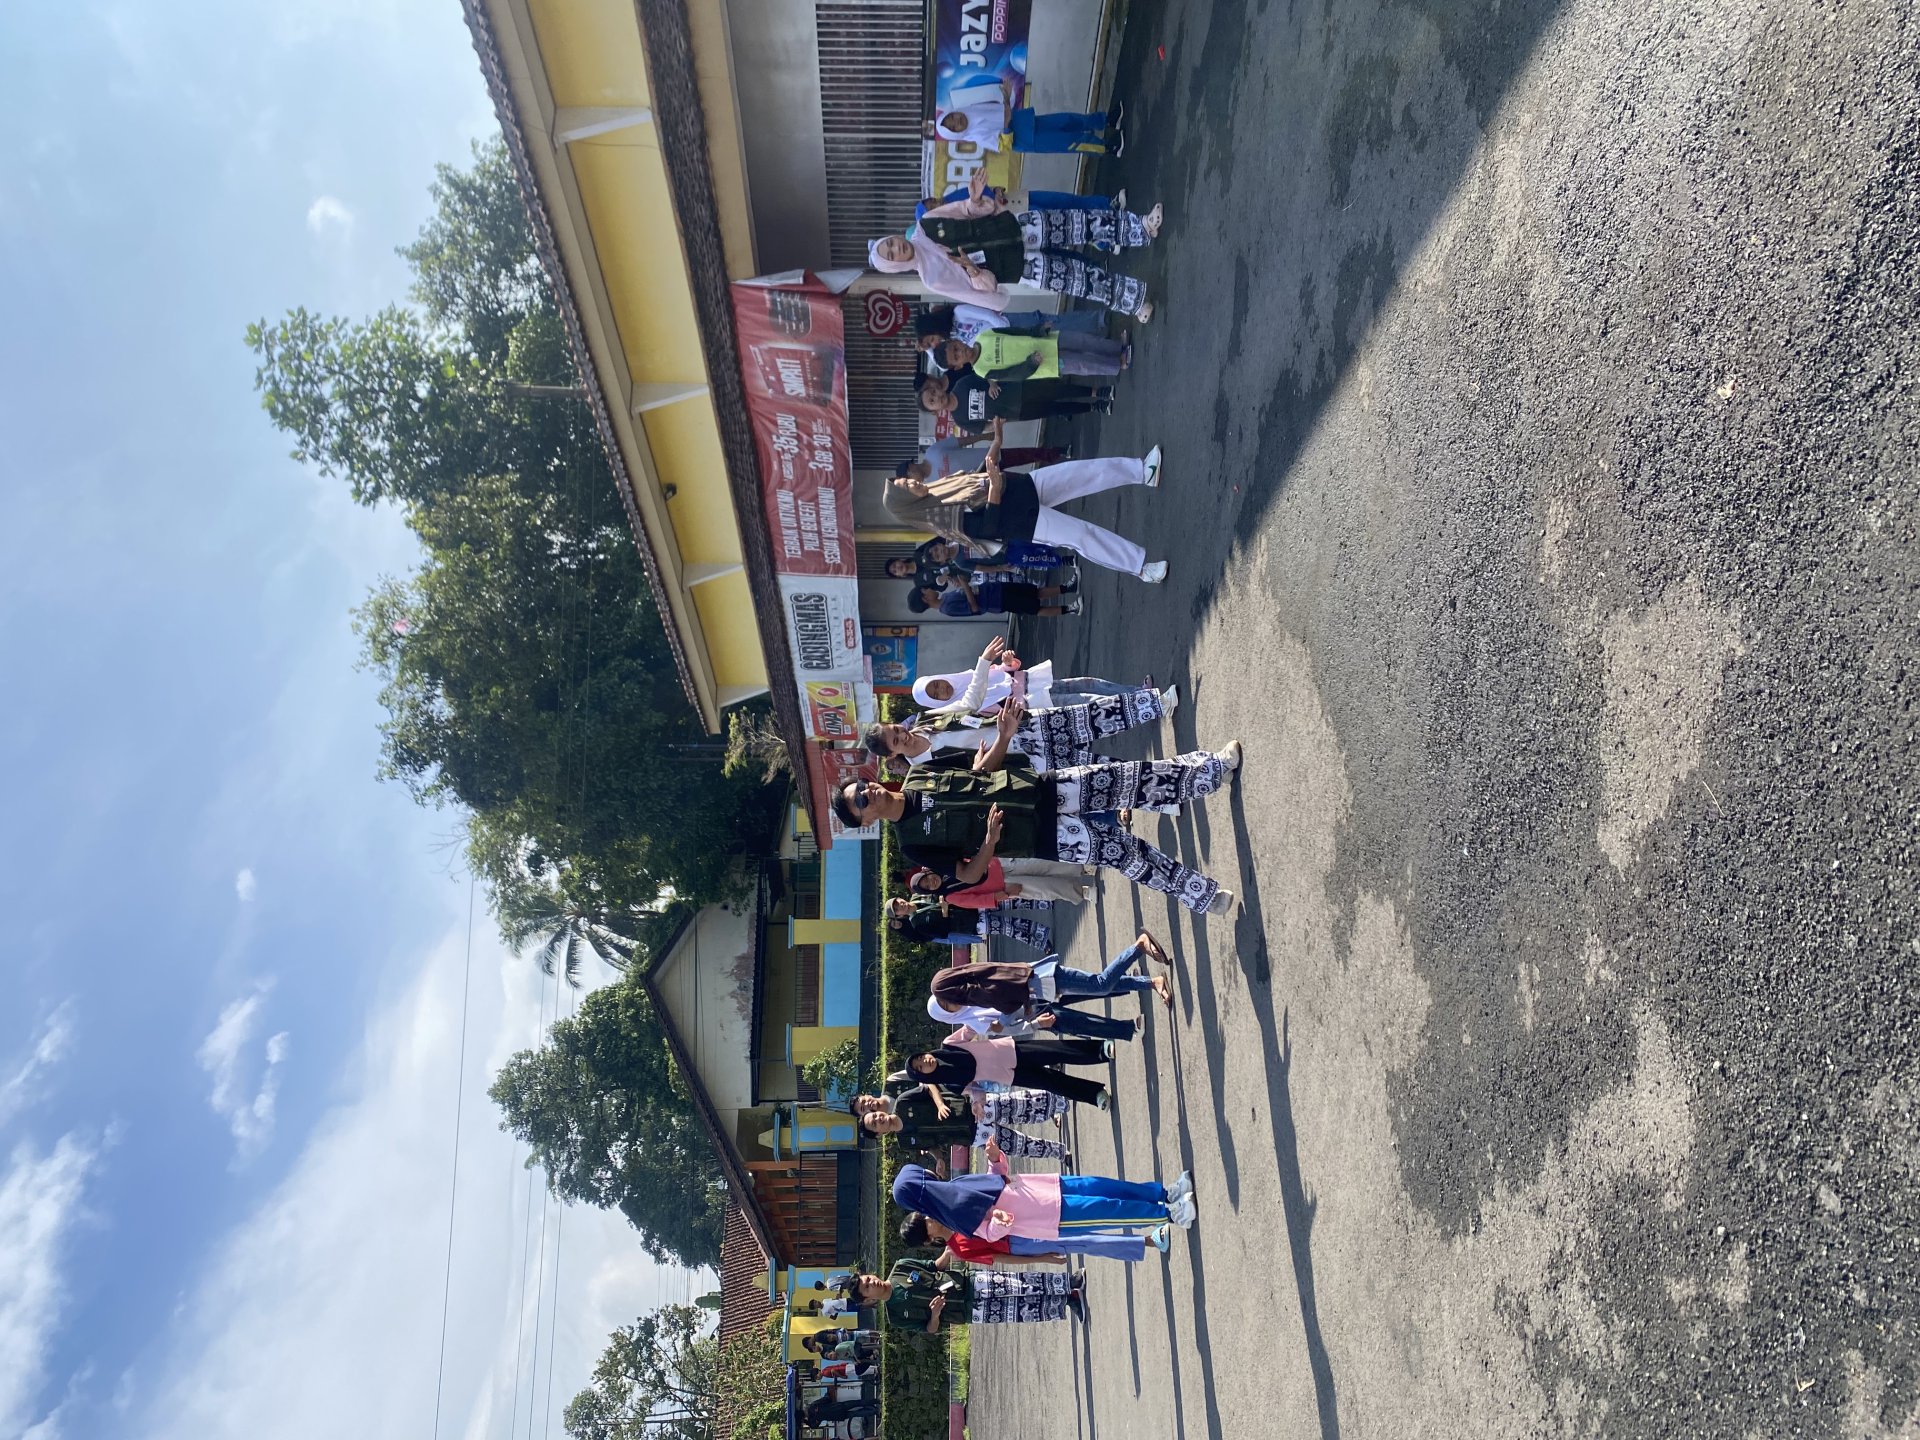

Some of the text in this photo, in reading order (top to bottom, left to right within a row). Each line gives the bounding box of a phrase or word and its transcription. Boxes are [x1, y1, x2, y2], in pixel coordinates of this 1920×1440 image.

[896, 301, 904, 324] WALL'S
[776, 358, 806, 396] SIMPATI
[776, 413, 797, 436] RIBU
[813, 435, 832, 447] 30
[772, 435, 799, 453] 35
[776, 490, 797, 527] UNTUKMU
[798, 500, 820, 550] PILIH BENEFIT
[818, 486, 840, 564] SESUAI KEINGINANMU
[782, 528, 801, 558] TERBAIK
[790, 593, 834, 670] GADINGMAS
